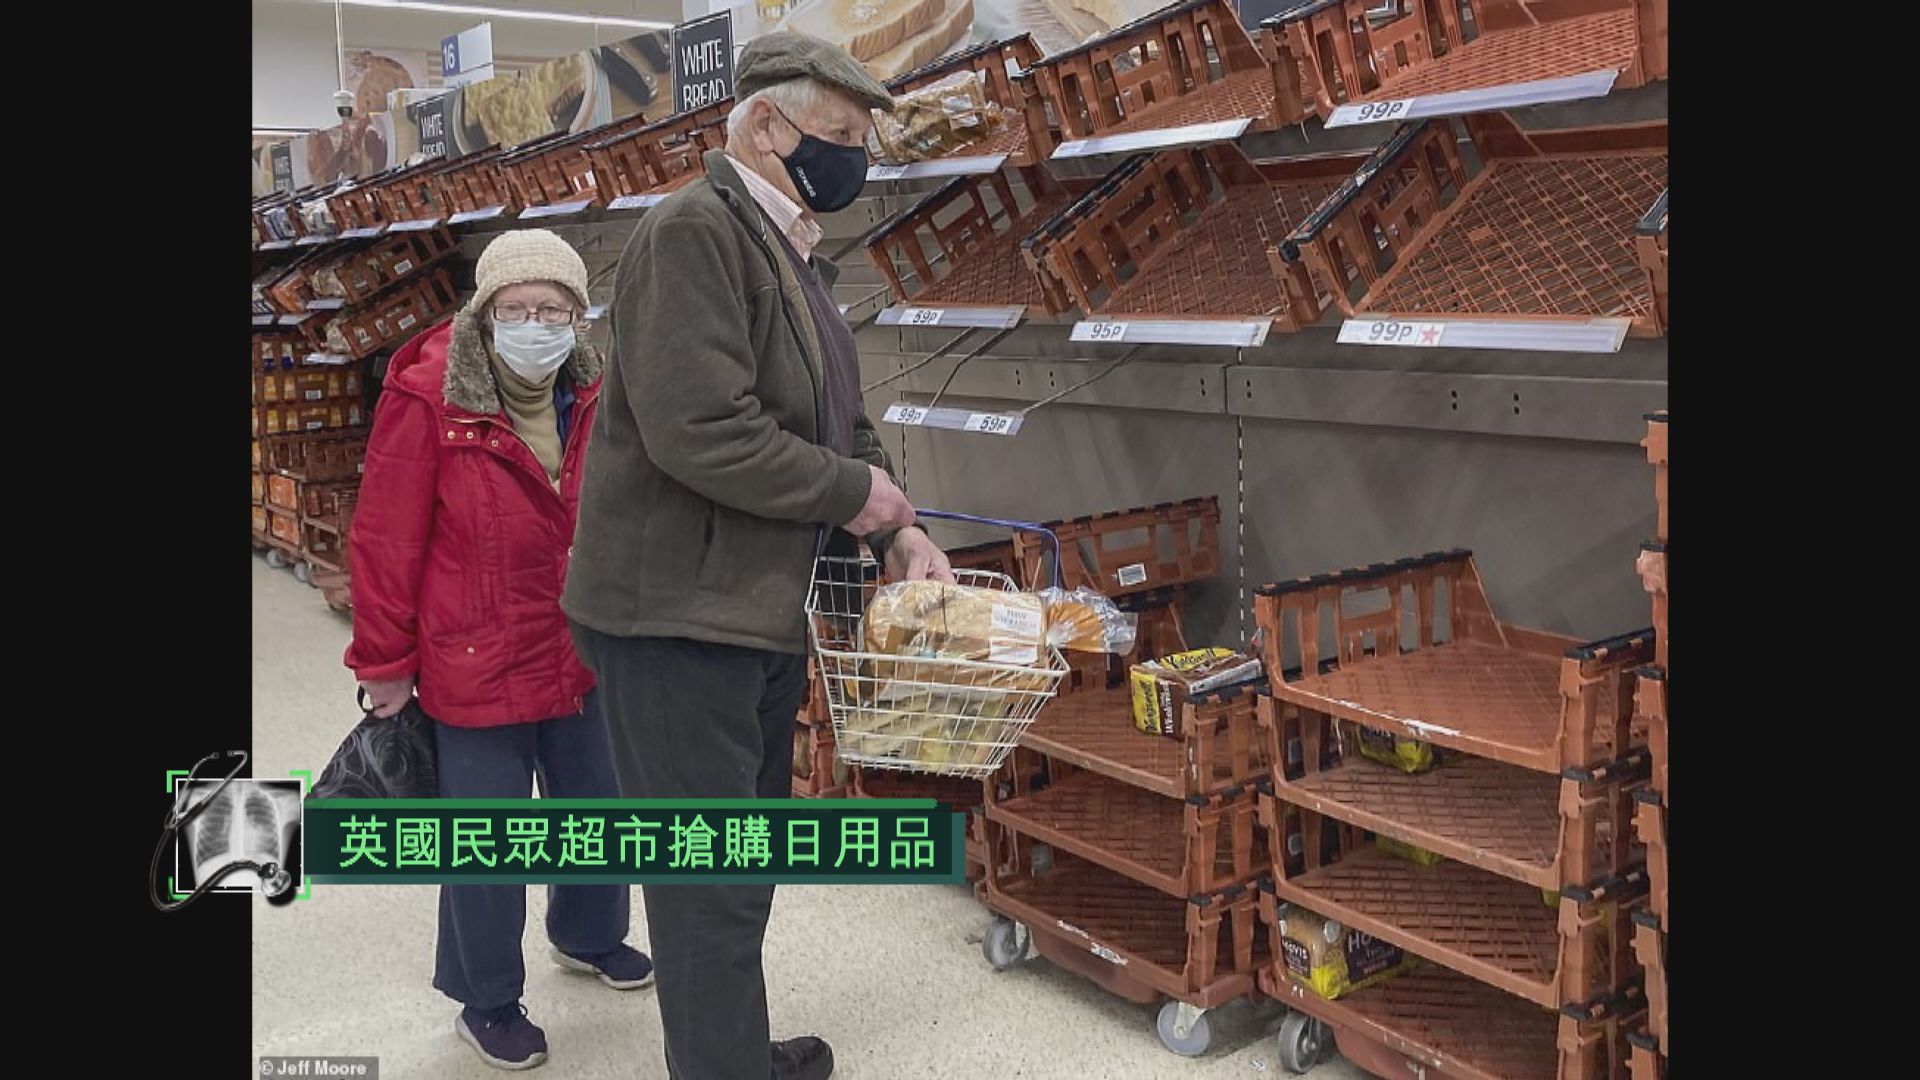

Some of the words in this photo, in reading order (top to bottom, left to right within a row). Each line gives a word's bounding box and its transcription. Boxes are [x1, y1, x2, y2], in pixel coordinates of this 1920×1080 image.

[443, 43, 455, 71] 16
[681, 38, 723, 77] WHITE
[420, 113, 443, 138] WHITE
